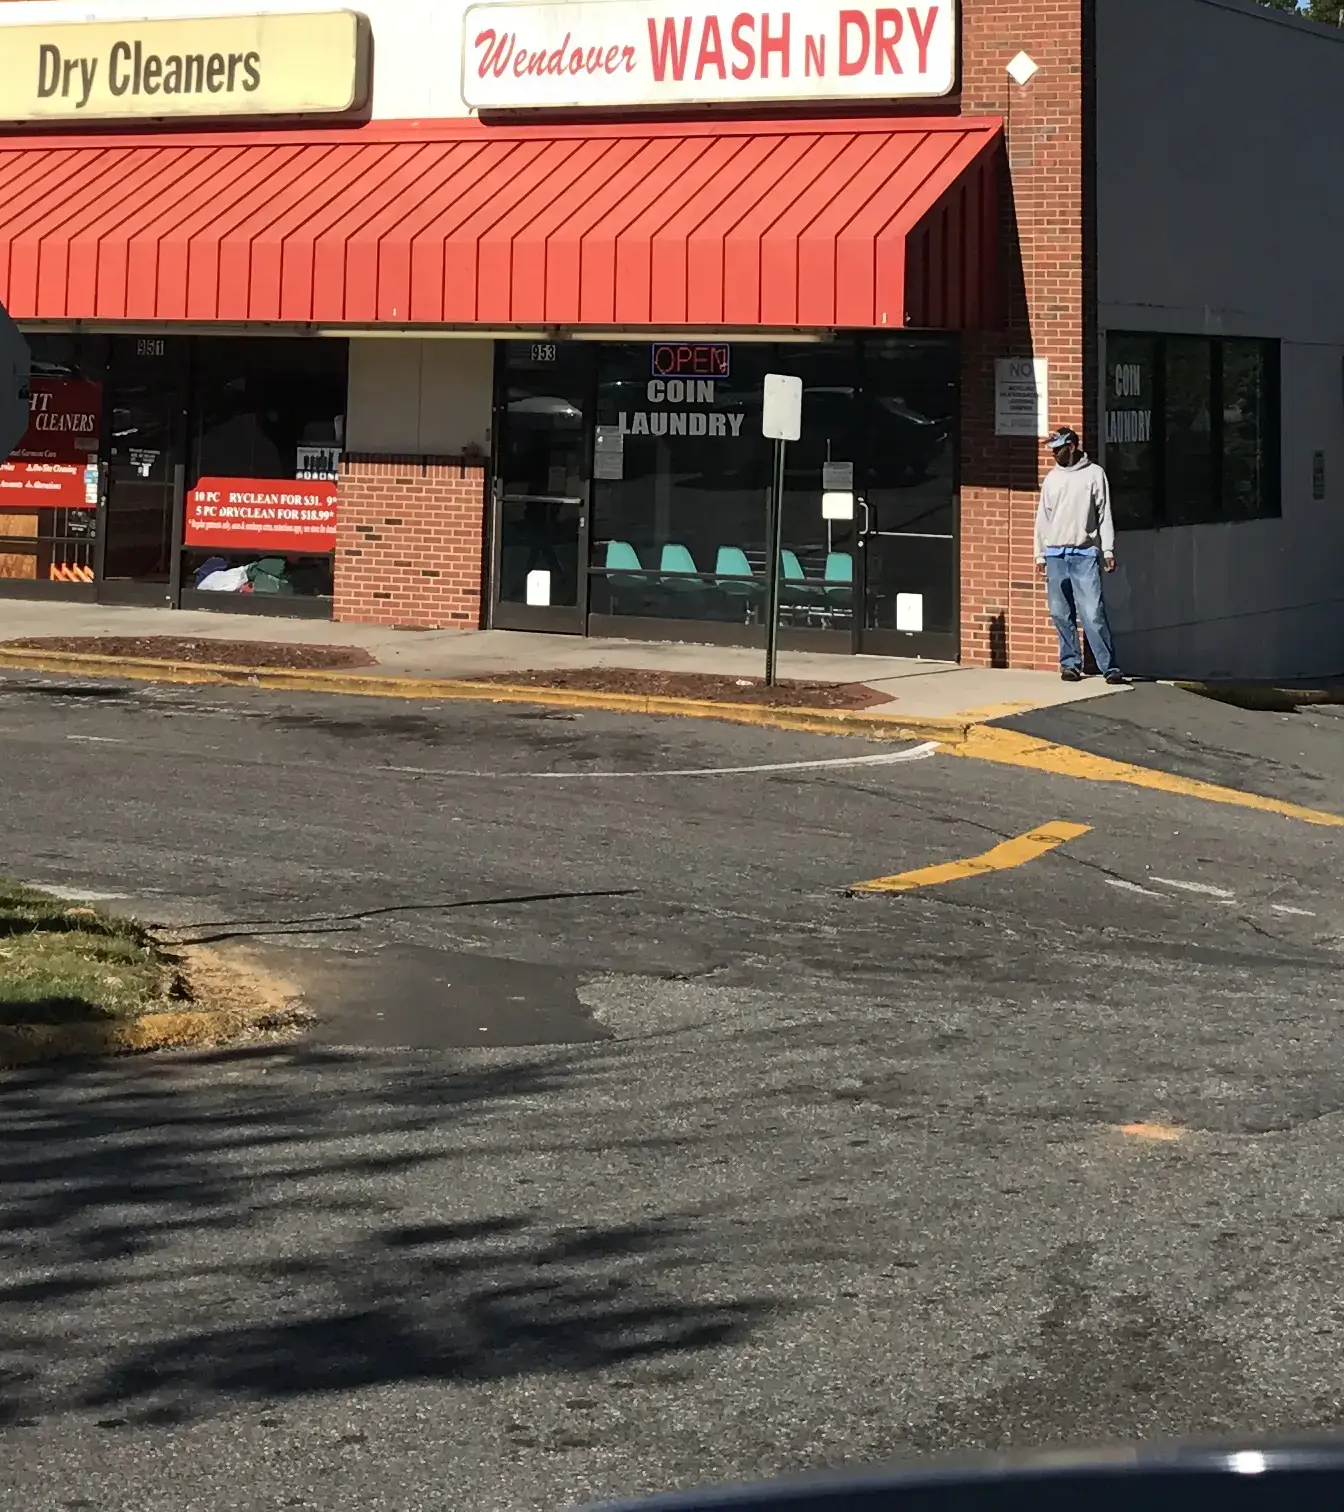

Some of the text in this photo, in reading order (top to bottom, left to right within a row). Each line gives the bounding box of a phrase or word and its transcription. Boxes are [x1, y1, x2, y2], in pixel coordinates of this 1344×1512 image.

[475, 6, 939, 81] Wendover WASH N DRY
[37, 40, 261, 109] Dry Cleaners
[137, 339, 164, 356] 951
[532, 344, 556, 360] 953
[655, 347, 727, 373] OPEN
[1009, 362, 1033, 378] NO
[647, 379, 714, 403] COIN
[1115, 364, 1140, 396] COIN
[35, 413, 95, 432] CLEANERS
[618, 411, 745, 436] LAUNDRY
[1106, 410, 1151, 443] LAUNDRY
[194, 491, 205, 502] 10
[206, 491, 221, 502] PC
[280, 493, 302, 505] FOR
[195, 505, 202, 515] 5
[203, 505, 218, 516] PC
[219, 506, 275, 519] DRYCLEAN
[277, 508, 299, 520] FOR
